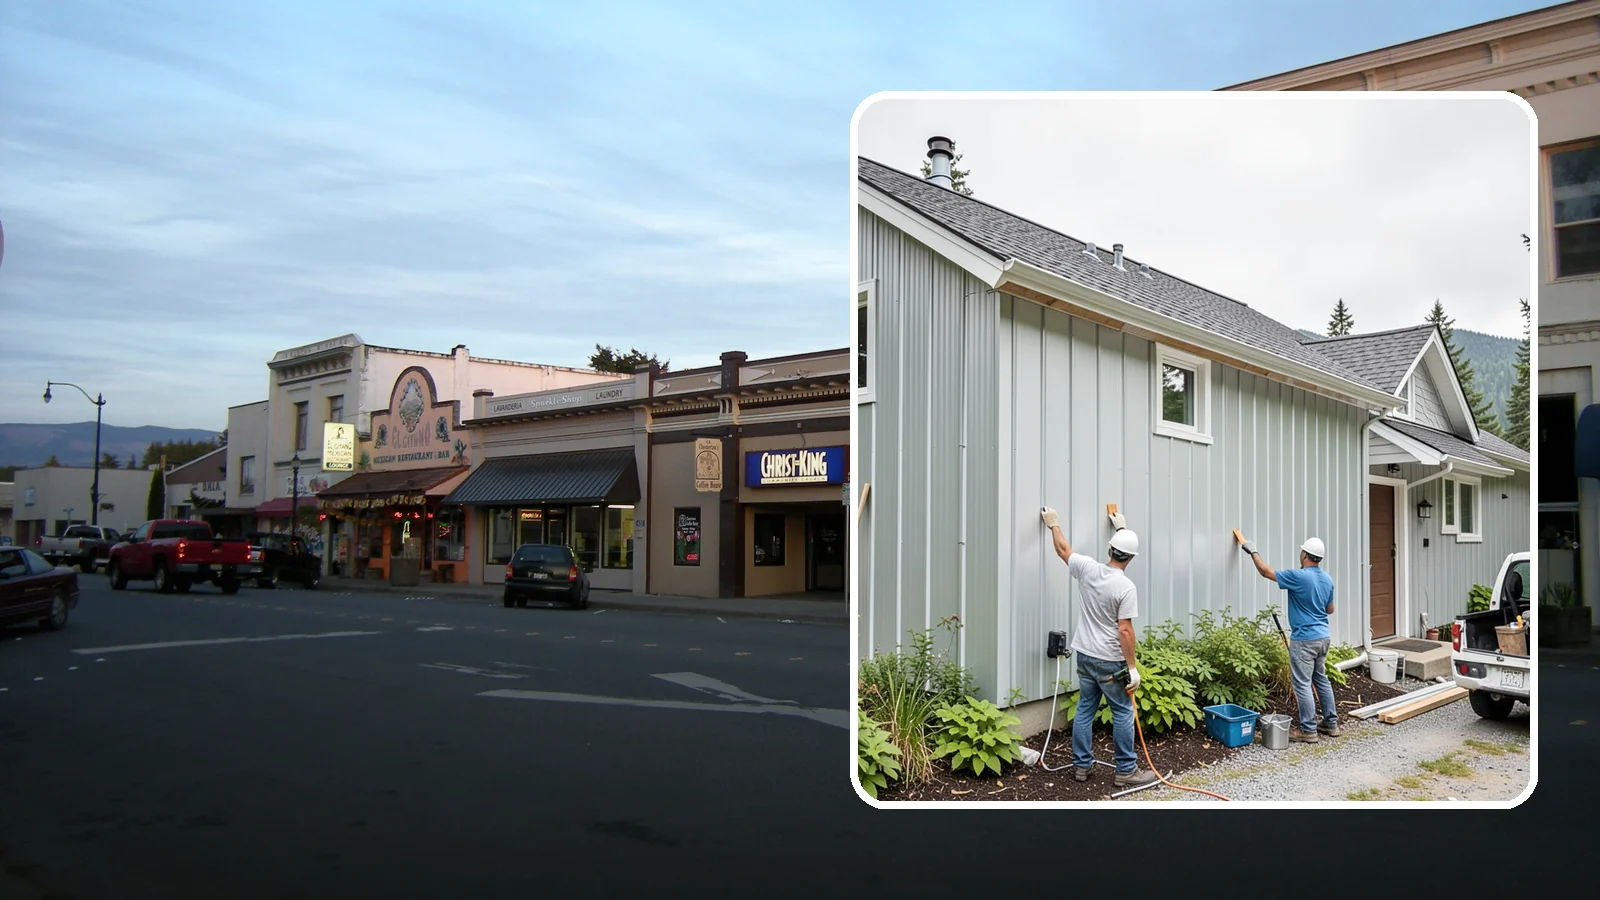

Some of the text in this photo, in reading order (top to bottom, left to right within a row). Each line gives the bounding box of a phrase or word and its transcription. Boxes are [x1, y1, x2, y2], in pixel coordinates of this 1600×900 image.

[493, 388, 623, 412] LAVANDERIA Sparkle Shop LAUNDRY
[373, 454, 396, 464] MEXICAN
[397, 451, 433, 462] RESTAURANT
[437, 450, 450, 459] BAR
[760, 450, 827, 477] CHRIST KING
[696, 480, 722, 488] Coffee House
